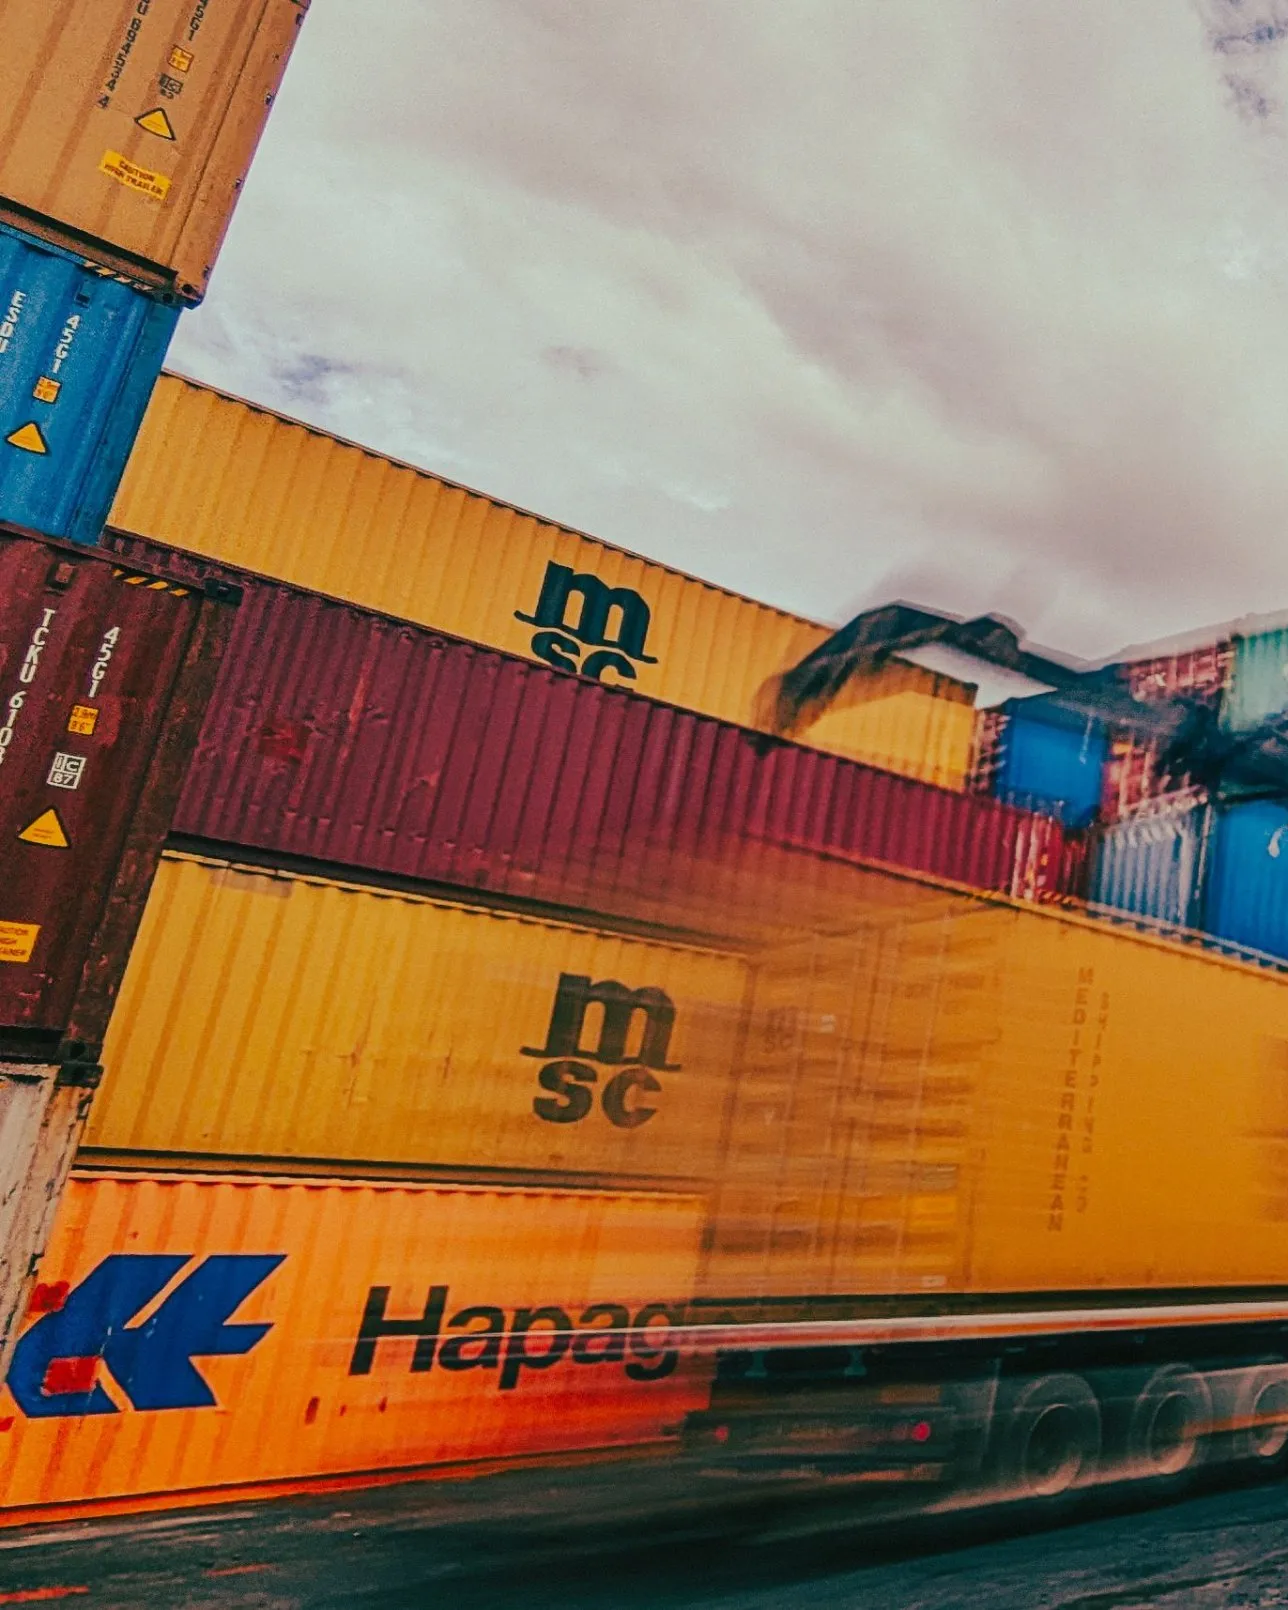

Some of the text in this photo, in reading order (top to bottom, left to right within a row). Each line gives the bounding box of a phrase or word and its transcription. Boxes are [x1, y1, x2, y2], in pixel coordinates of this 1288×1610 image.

[52, 314, 80, 374] 45G1
[20, 608, 56, 683] TCKU
[88, 626, 120, 698] 45G1
[1046, 966, 1094, 1232] MEDITERRANEAN
